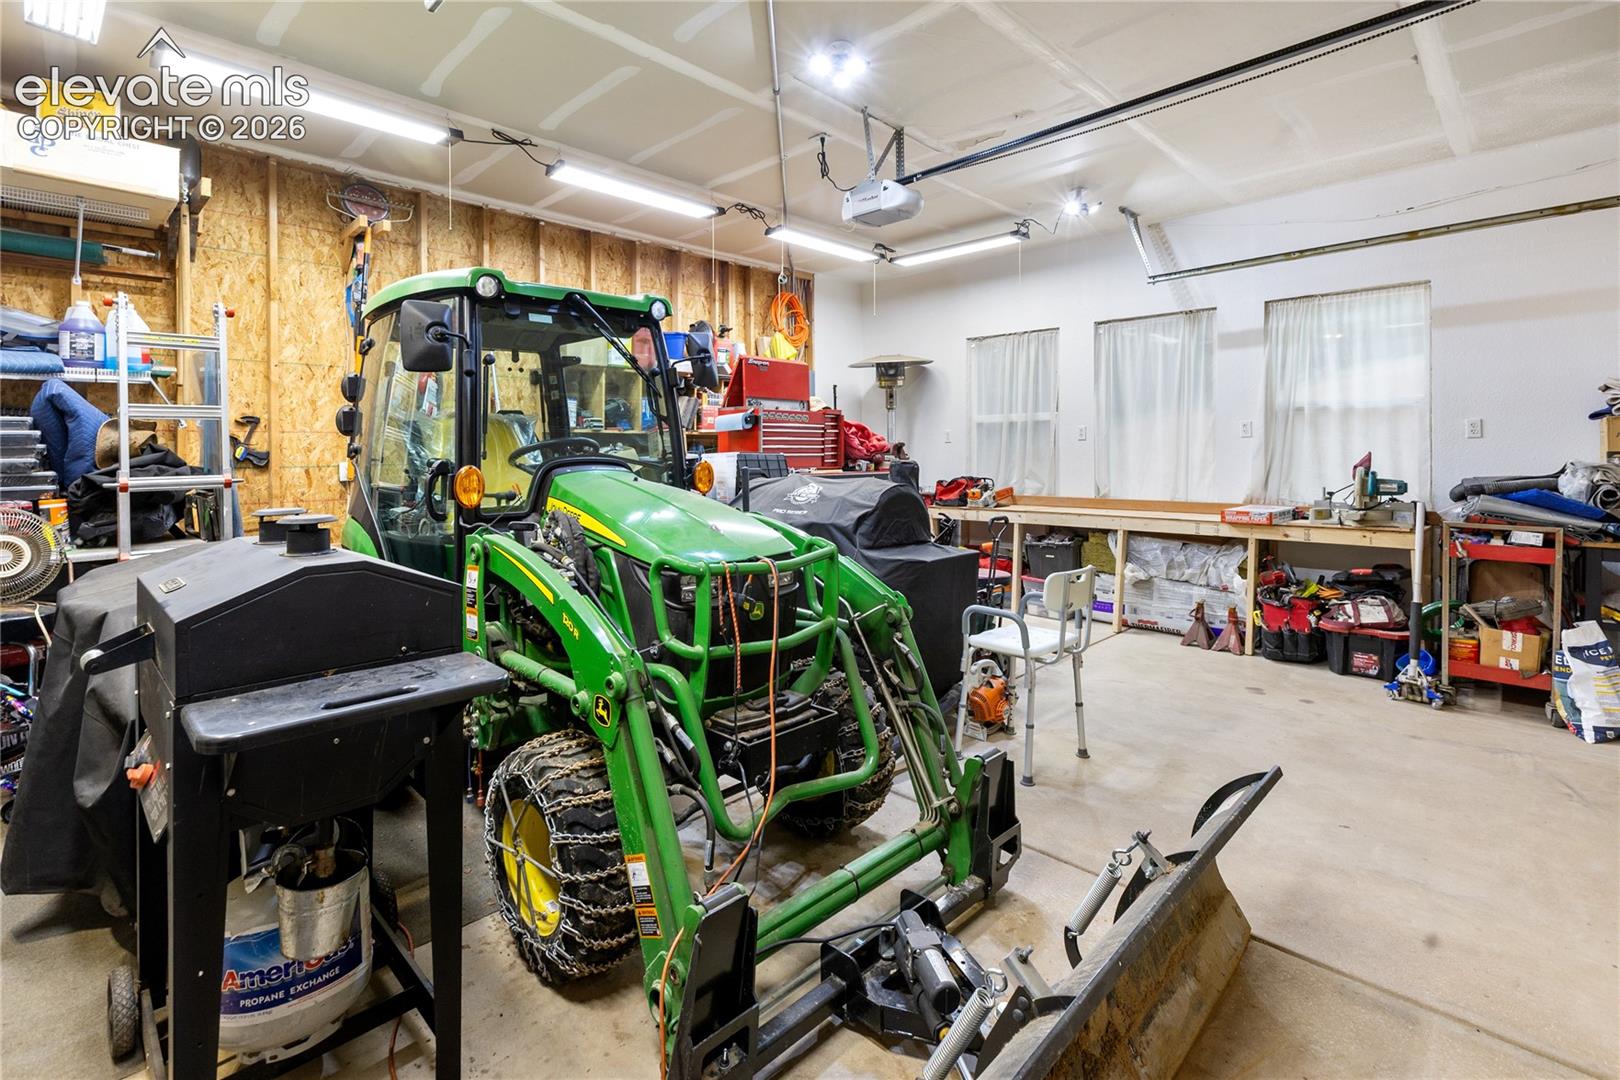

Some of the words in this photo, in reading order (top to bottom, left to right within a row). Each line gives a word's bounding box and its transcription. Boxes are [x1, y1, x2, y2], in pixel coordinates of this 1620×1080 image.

[1584, 648, 1607, 656] ICE
[240, 990, 285, 1008] PROPANE
[289, 966, 340, 995] EXCHANGE
